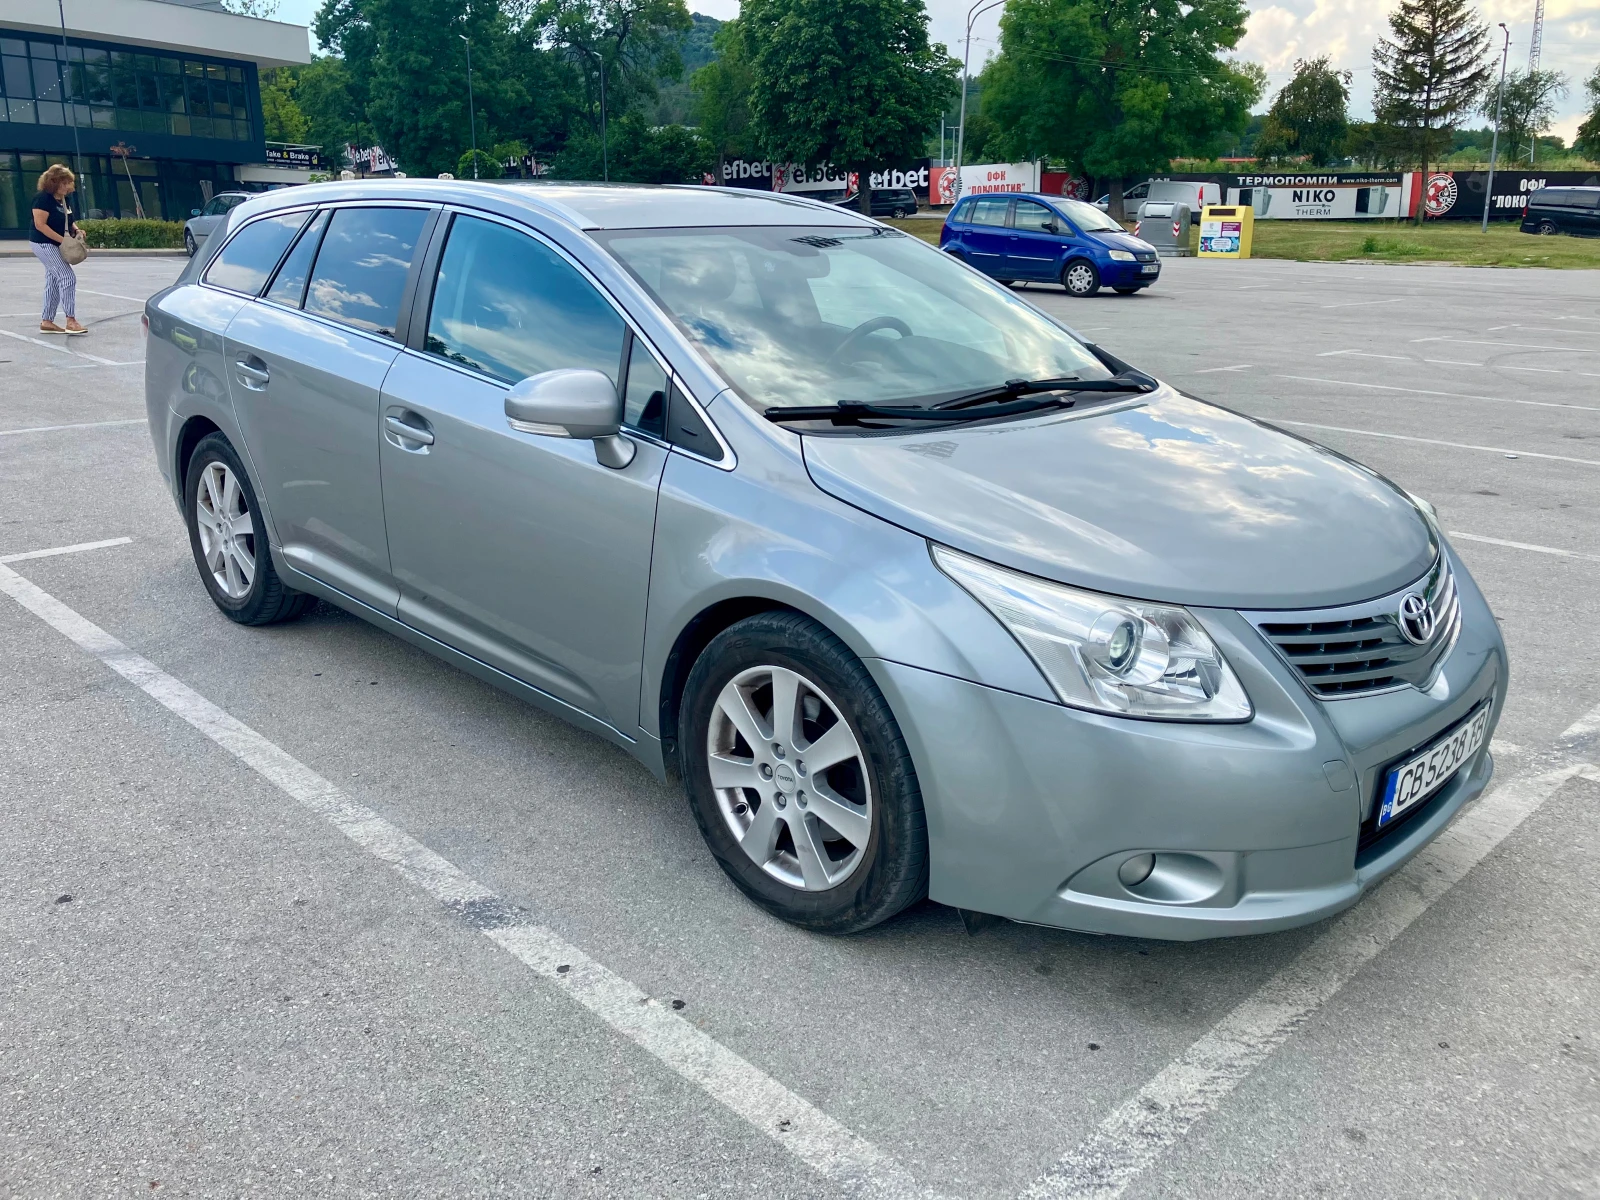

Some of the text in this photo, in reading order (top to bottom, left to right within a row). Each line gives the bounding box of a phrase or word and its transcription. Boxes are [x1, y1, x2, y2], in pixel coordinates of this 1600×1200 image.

[266, 150, 281, 158] Take
[290, 152, 309, 160] Brake
[722, 159, 771, 180] efbet
[869, 166, 928, 188] efbet
[1237, 176, 1338, 186] ТЕРМОПОМПИ
[1520, 178, 1547, 192] ОФК
[1292, 189, 1336, 203] NIKO
[1295, 208, 1331, 216] THERM
[1396, 761, 1426, 806] CB
[1425, 728, 1469, 788] 5238
